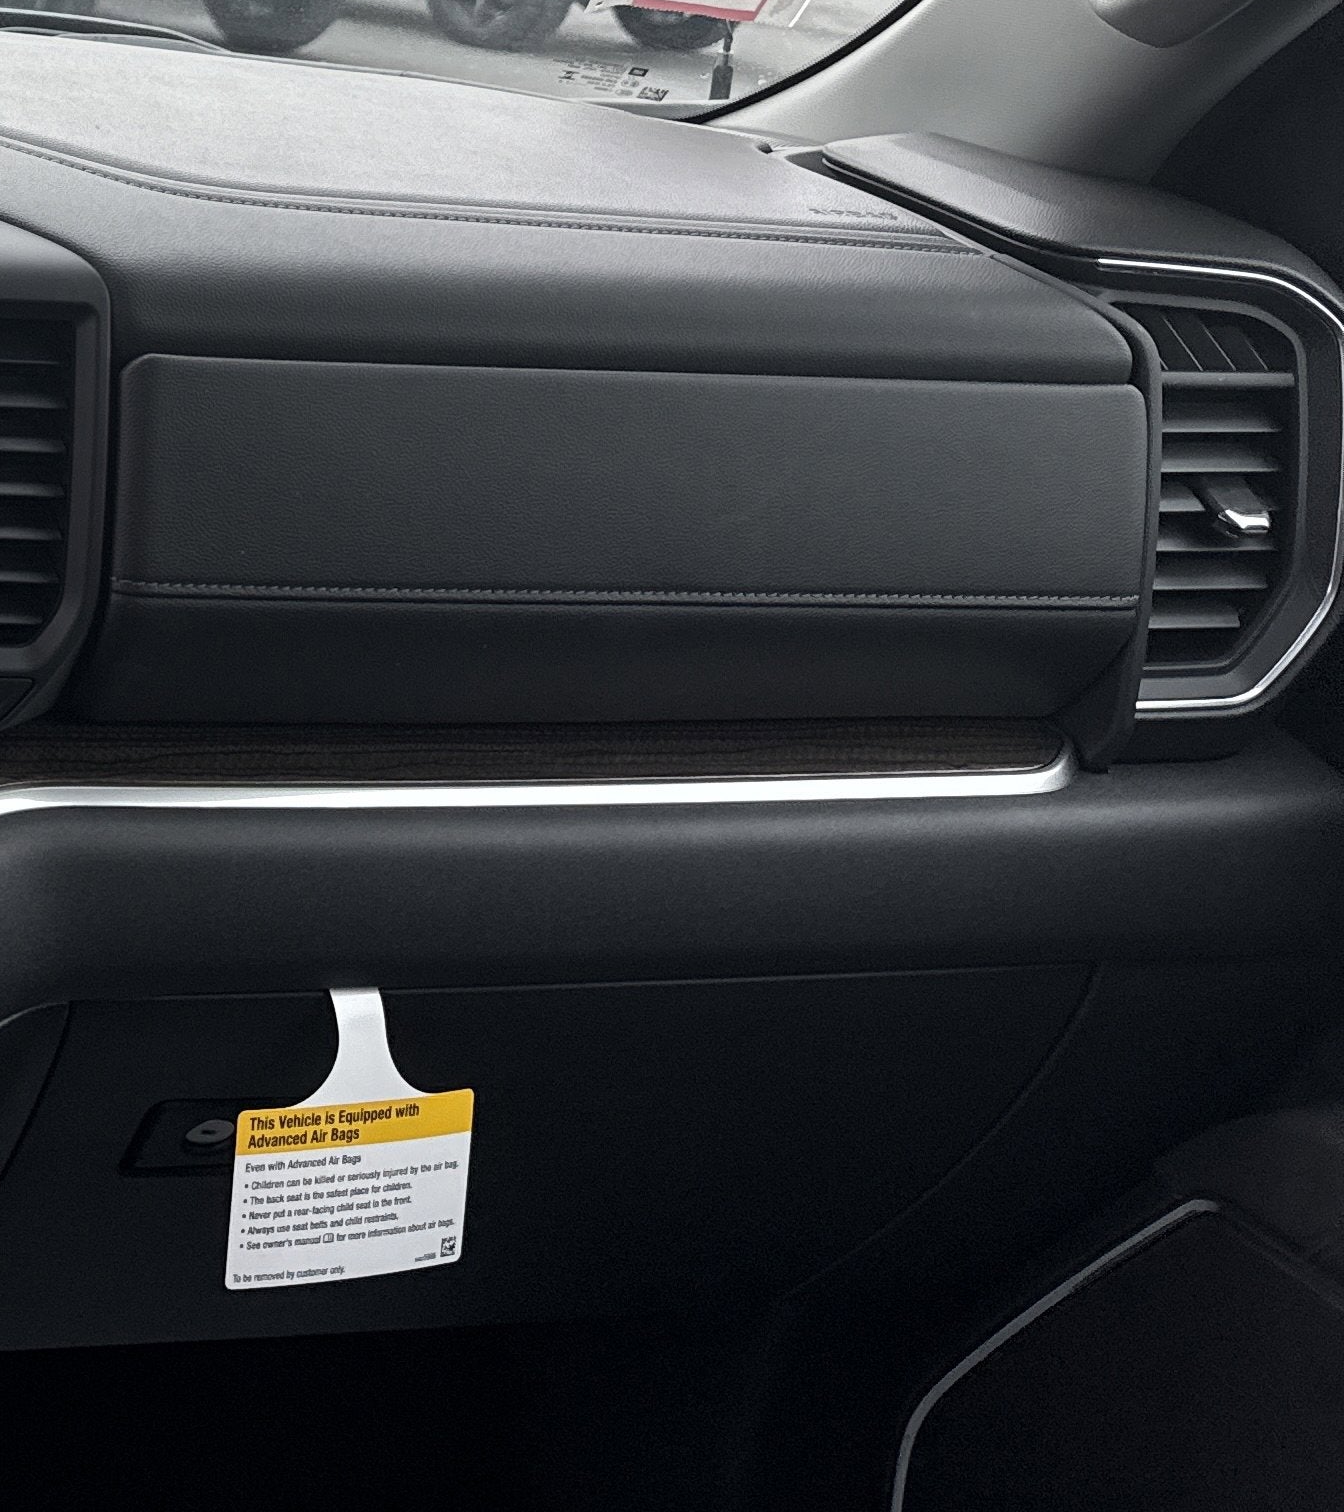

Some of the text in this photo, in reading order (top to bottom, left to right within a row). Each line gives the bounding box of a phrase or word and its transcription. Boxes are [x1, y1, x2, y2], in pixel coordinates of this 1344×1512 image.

[250, 1116, 275, 1131] This
[279, 1112, 321, 1129] Vehicle
[339, 1106, 392, 1125] Equipped
[395, 1103, 420, 1118] with
[248, 1128, 360, 1149] Advanced Air Bags
[245, 1155, 361, 1173] Even with Advanced Air Bags
[251, 1180, 284, 1190] Children
[286, 1179, 300, 1187] can
[303, 1177, 312, 1186] be
[250, 1196, 264, 1205] The
[246, 1241, 260, 1250] See
